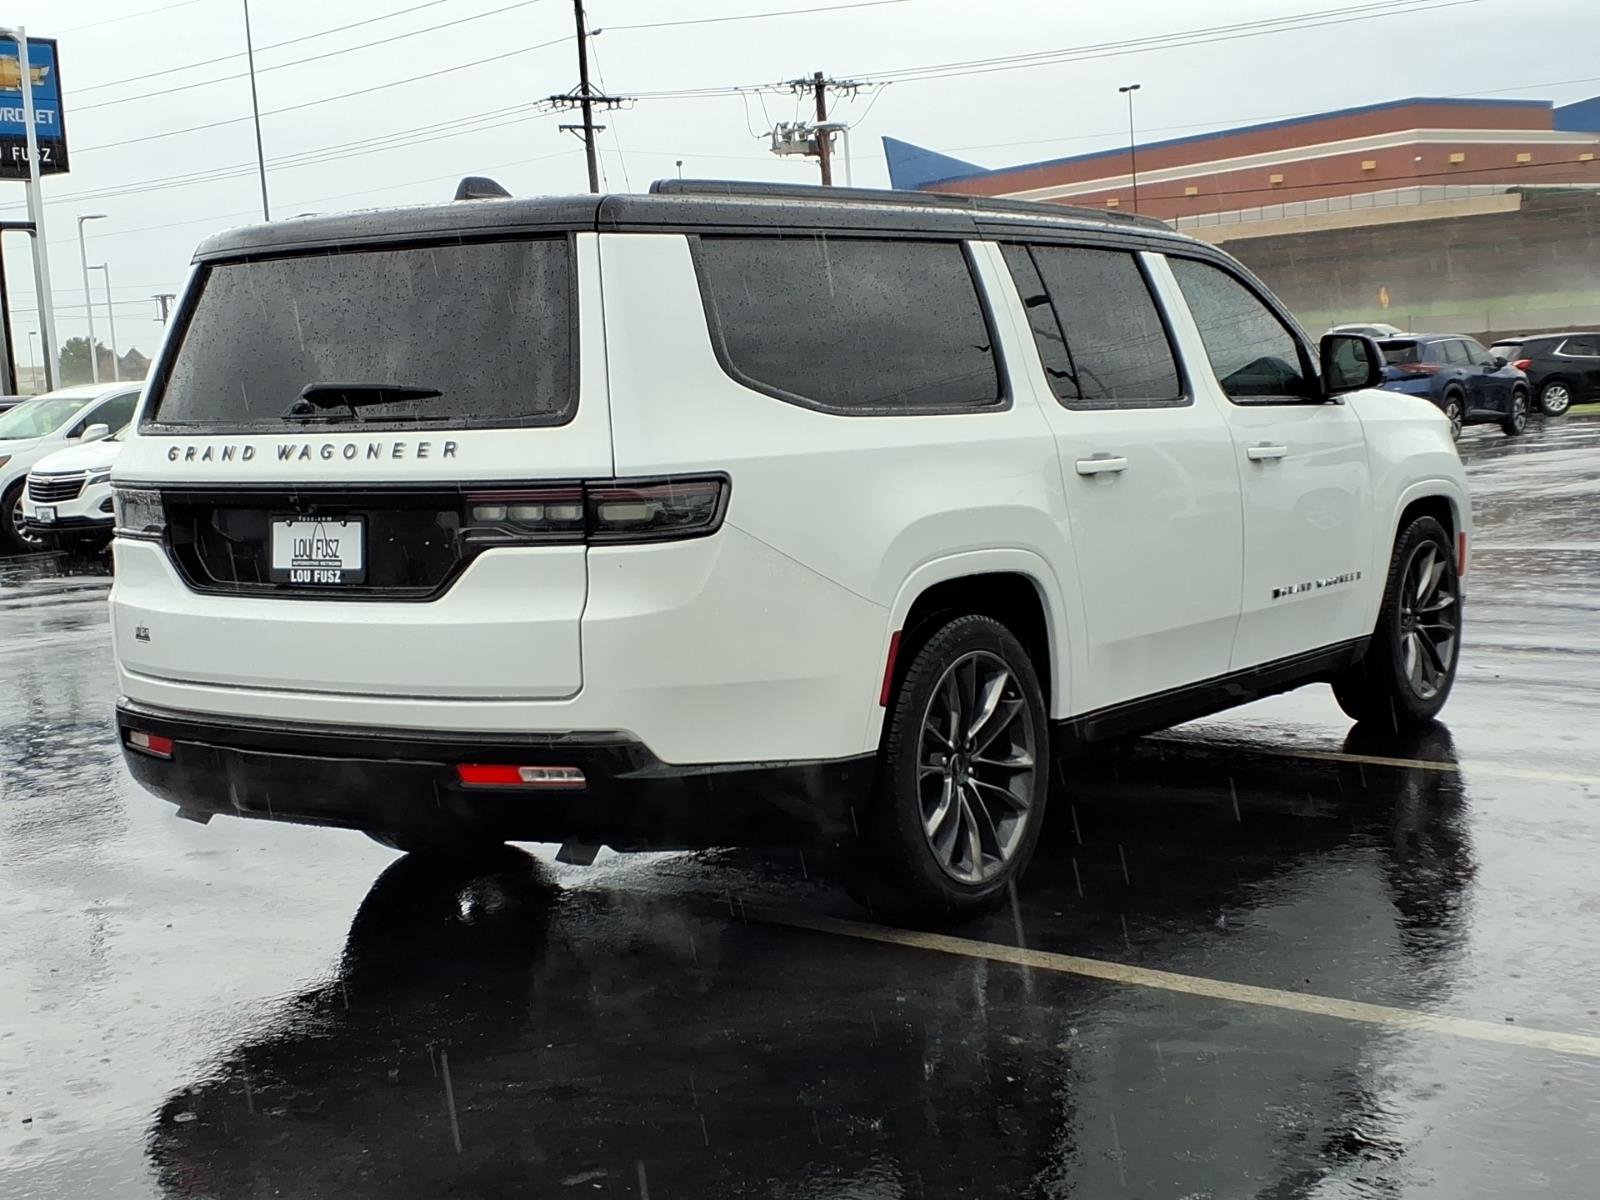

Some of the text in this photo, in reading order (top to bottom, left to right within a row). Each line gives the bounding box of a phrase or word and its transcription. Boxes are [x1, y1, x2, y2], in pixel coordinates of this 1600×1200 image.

[0, 107, 55, 124] ROET
[167, 441, 458, 462] GRAND WAGONEER
[294, 538, 340, 558] LOU FUSZ
[290, 570, 341, 583] LOU FUSZ
